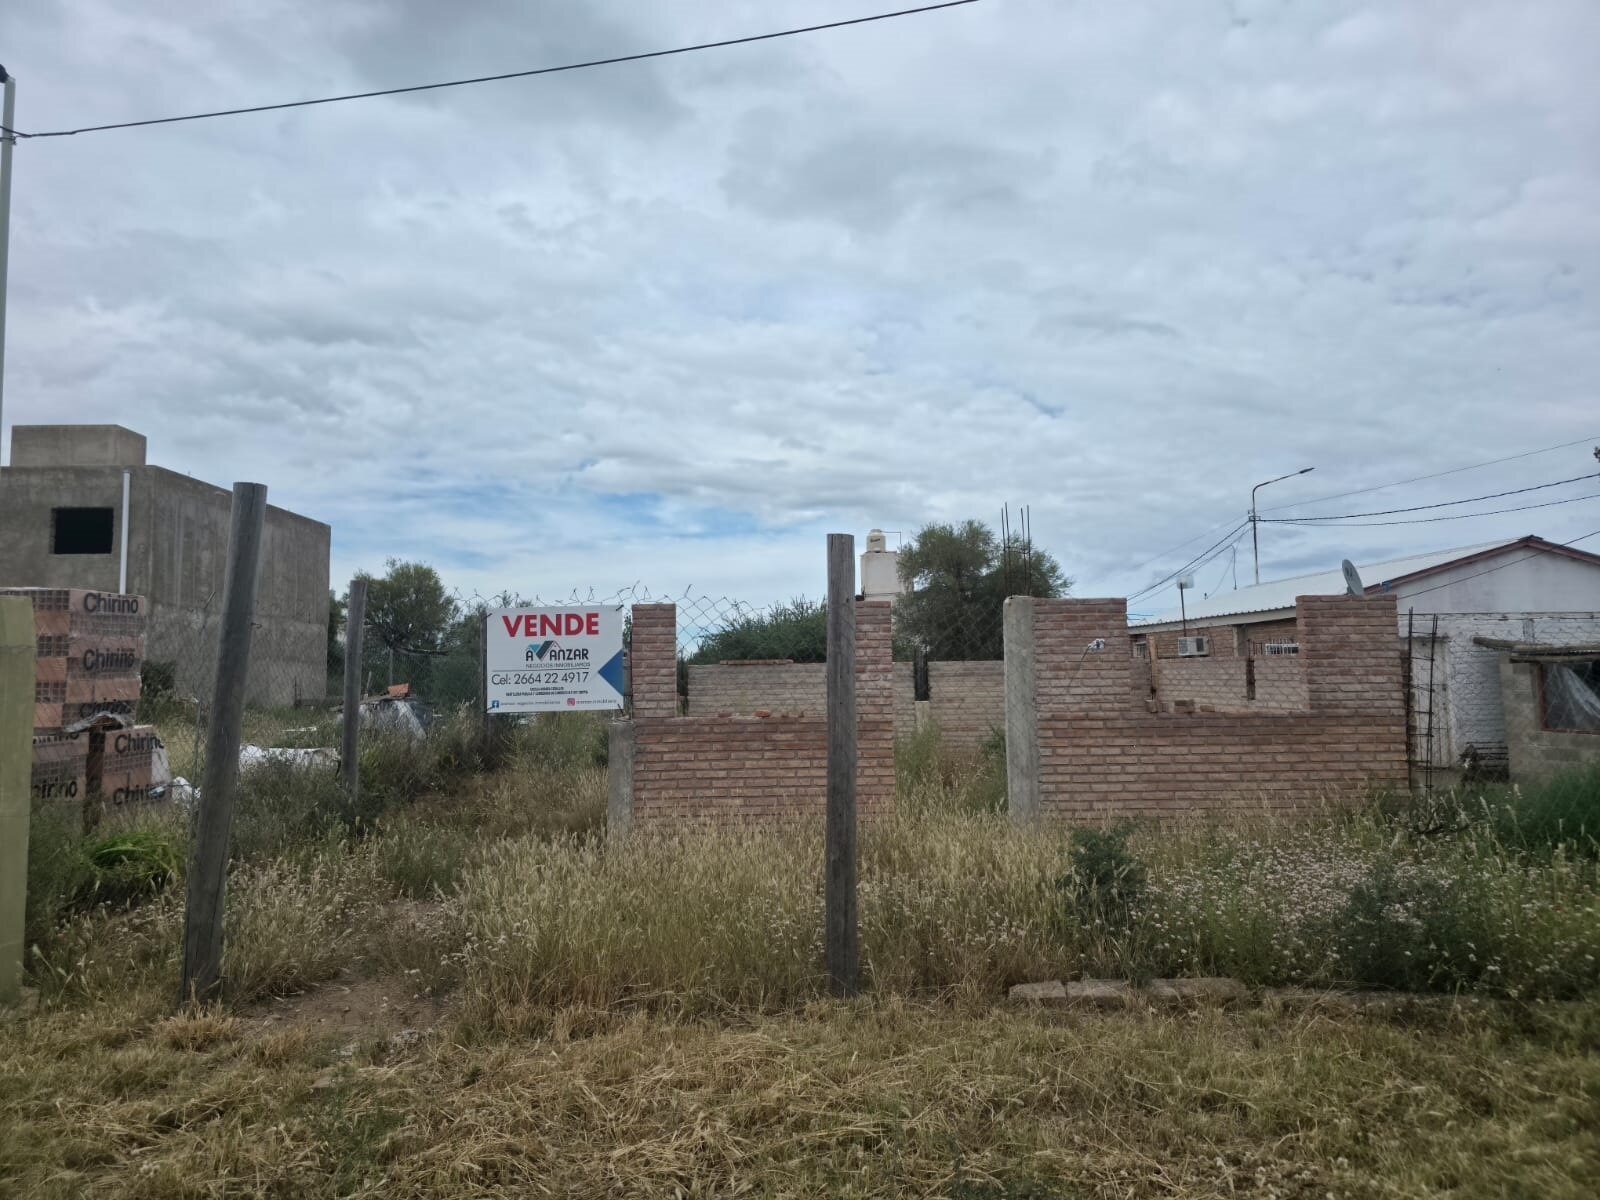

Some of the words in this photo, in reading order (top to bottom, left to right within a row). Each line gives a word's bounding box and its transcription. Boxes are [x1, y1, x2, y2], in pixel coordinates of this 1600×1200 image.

[83, 592, 139, 613] Chirino
[502, 612, 600, 638] VENDE
[83, 648, 136, 671] Chirino
[491, 673, 511, 685] Cel:
[513, 672, 541, 685] 2664
[544, 673, 558, 683] 22
[561, 671, 589, 682] 4917
